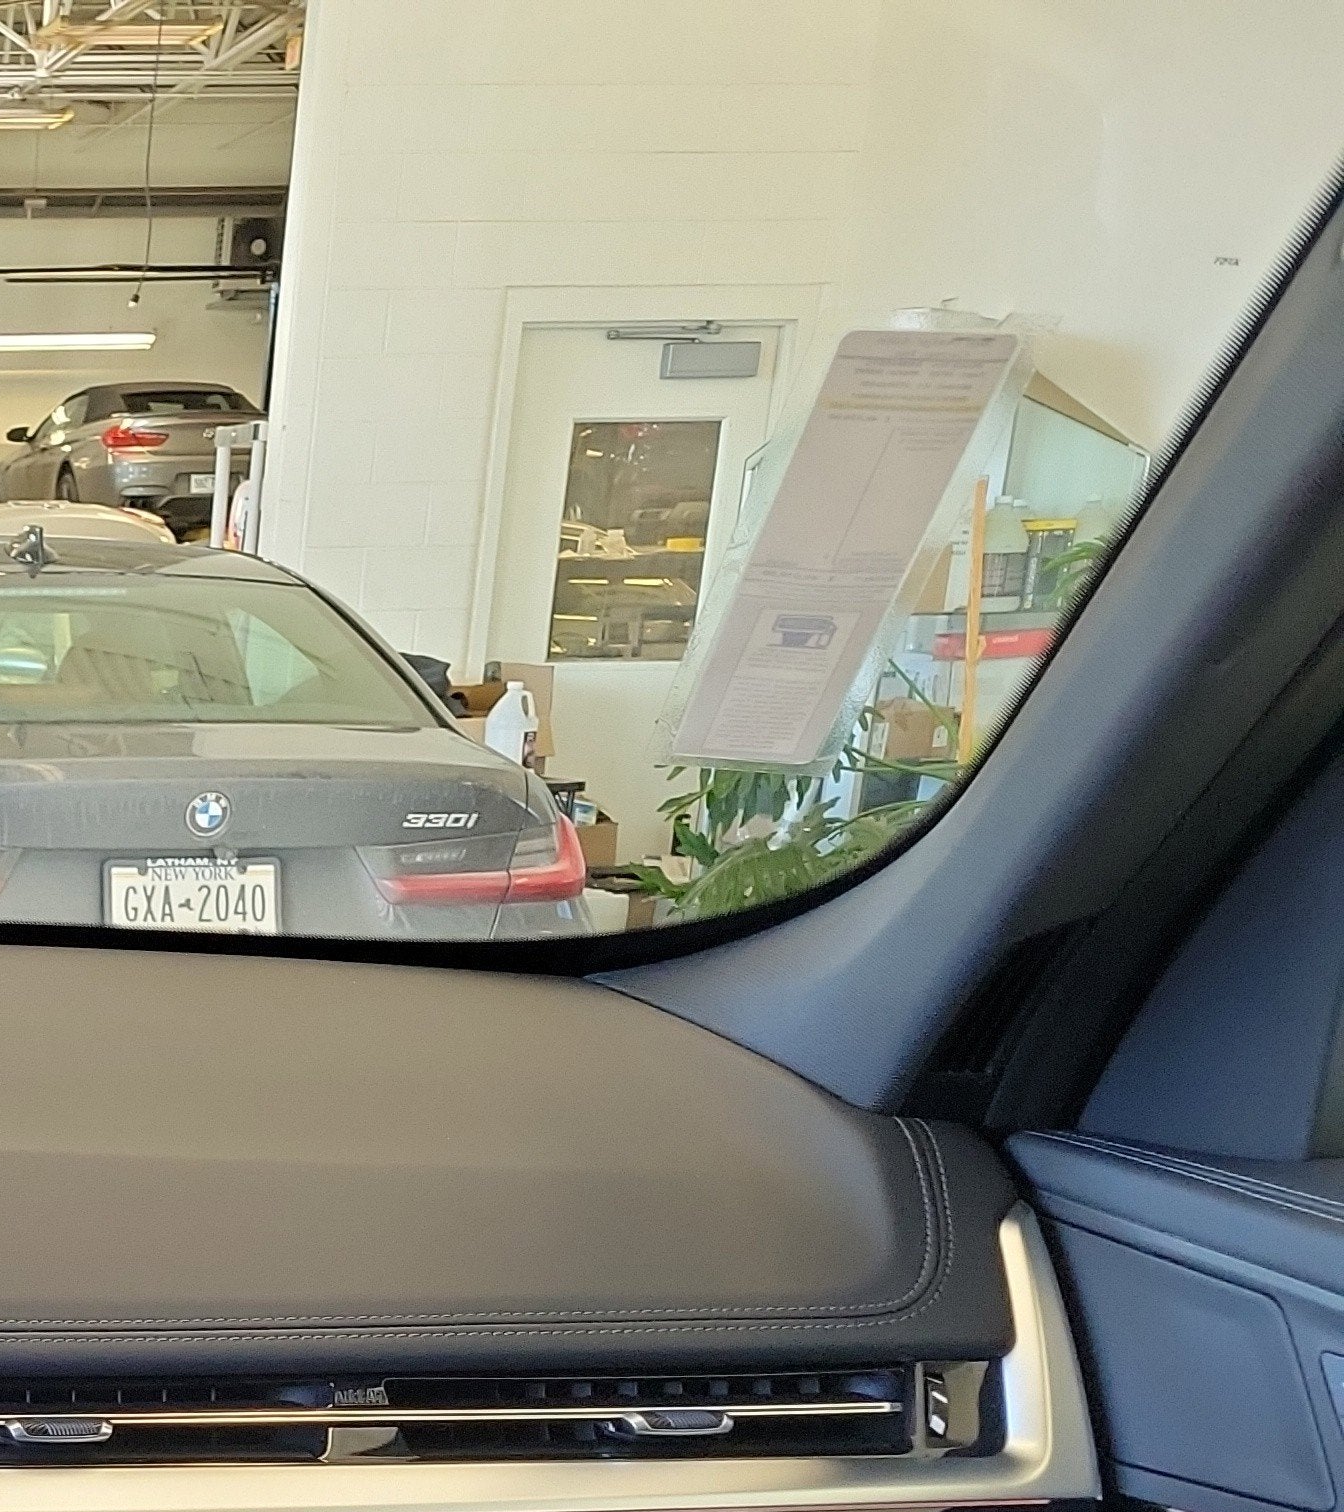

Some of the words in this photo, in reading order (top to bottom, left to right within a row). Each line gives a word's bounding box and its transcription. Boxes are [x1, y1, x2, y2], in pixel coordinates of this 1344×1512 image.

[216, 857, 239, 866] NY
[151, 868, 187, 882] NEW
[191, 867, 236, 881] YORK
[124, 885, 175, 922] GXA
[197, 884, 266, 922] 2040
